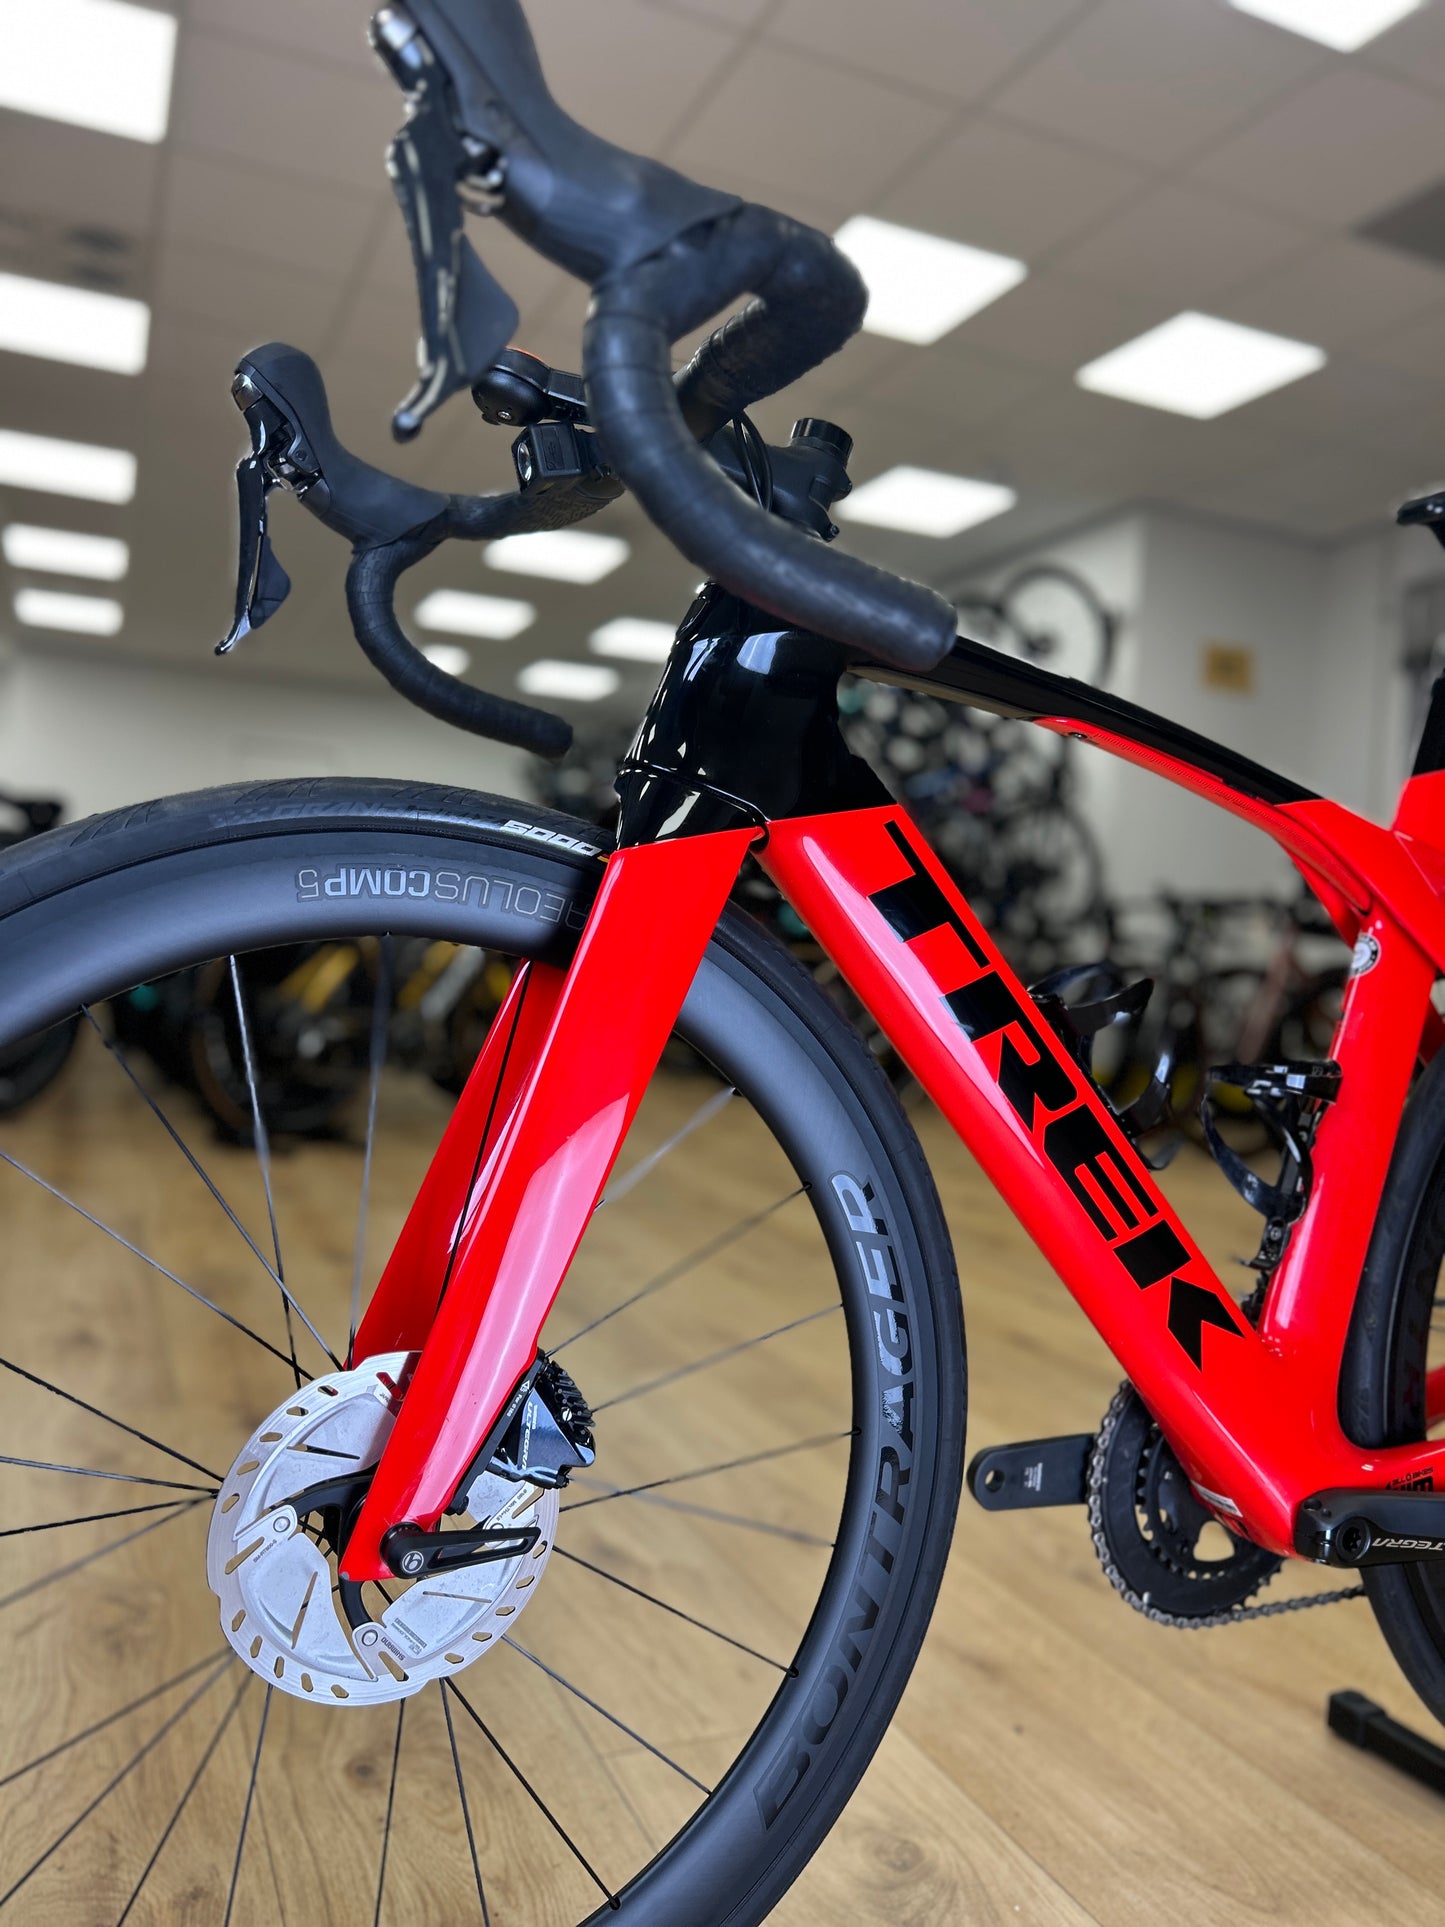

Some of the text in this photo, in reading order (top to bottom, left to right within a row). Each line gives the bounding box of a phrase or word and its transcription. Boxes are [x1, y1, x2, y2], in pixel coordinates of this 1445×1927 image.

[501, 819, 601, 857] 5000
[868, 819, 1245, 1371] TREK
[752, 1173, 905, 1832] BONTRAGER
[1372, 1538, 1445, 1551] TEGRA
